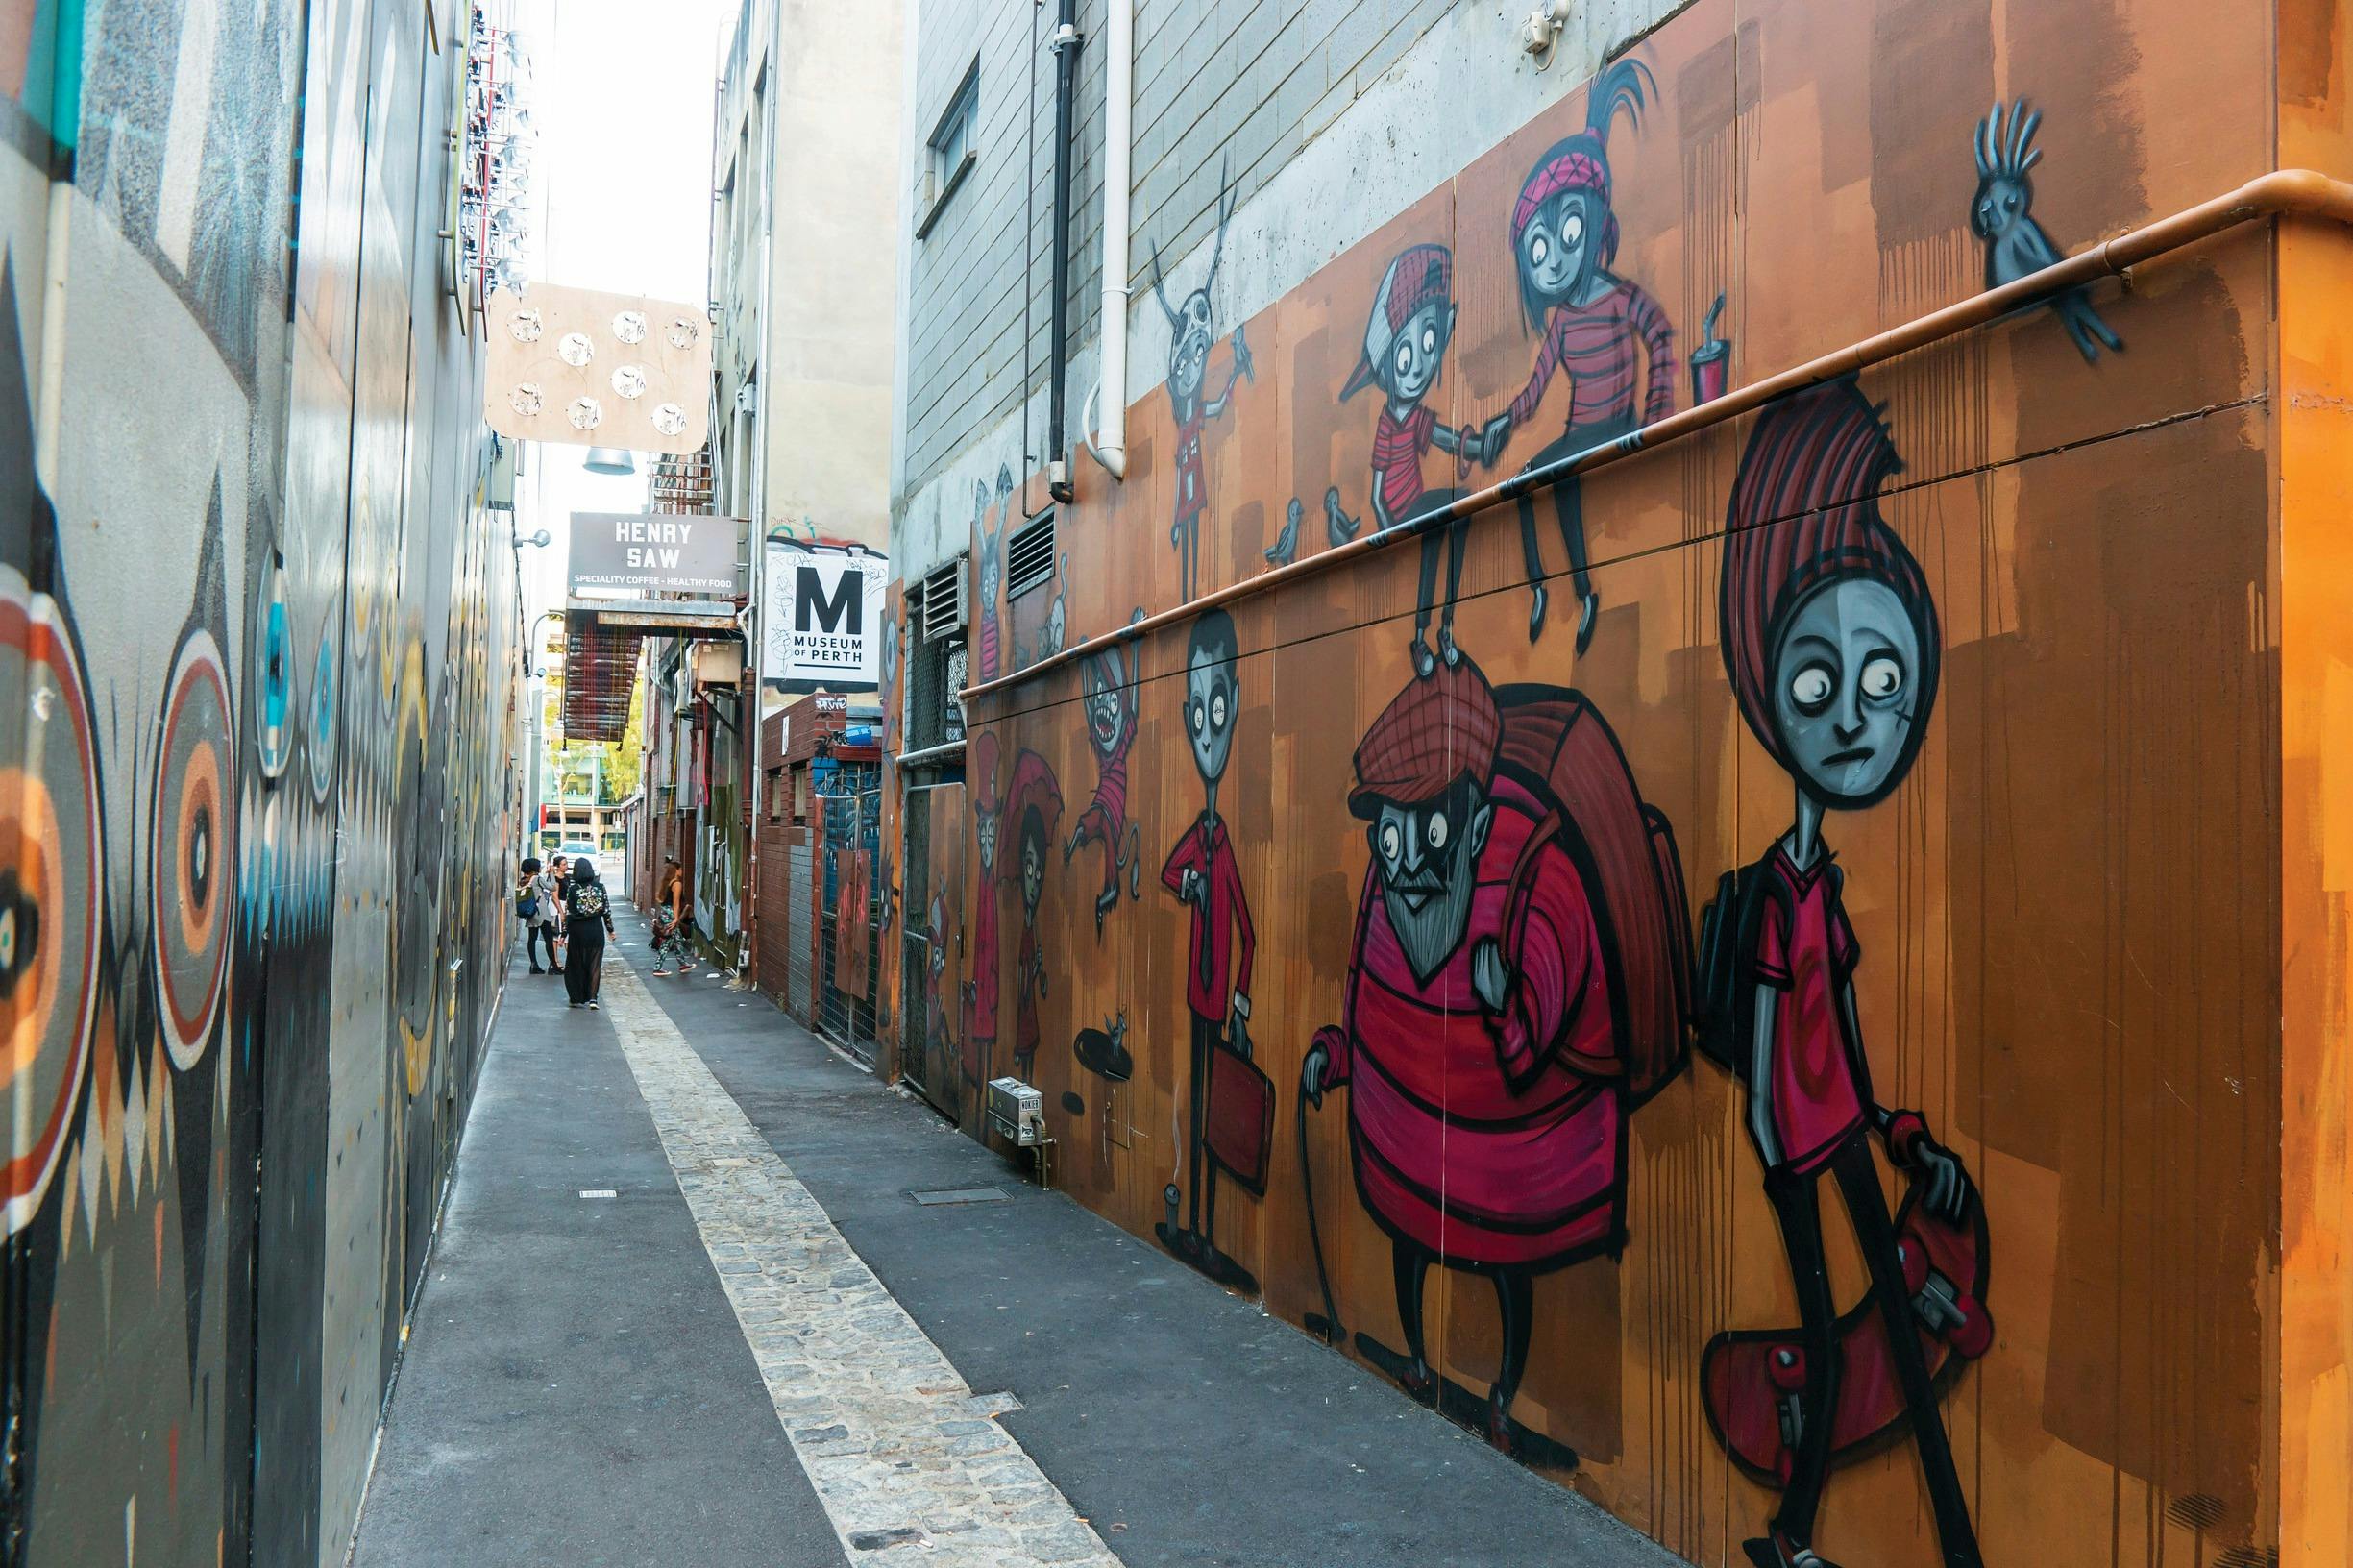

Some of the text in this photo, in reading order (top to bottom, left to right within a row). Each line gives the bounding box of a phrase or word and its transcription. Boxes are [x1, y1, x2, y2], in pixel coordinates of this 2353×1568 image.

[615, 522, 692, 544] HENRY
[626, 547, 680, 569] SAW
[574, 575, 625, 584] SPECIALITY
[626, 576, 660, 585] COFFEE
[666, 578, 707, 587] HEALTHY
[708, 579, 732, 588] FOOD
[795, 567, 863, 635] M
[794, 636, 862, 649] MUSEUM
[811, 650, 862, 662] PERTH
